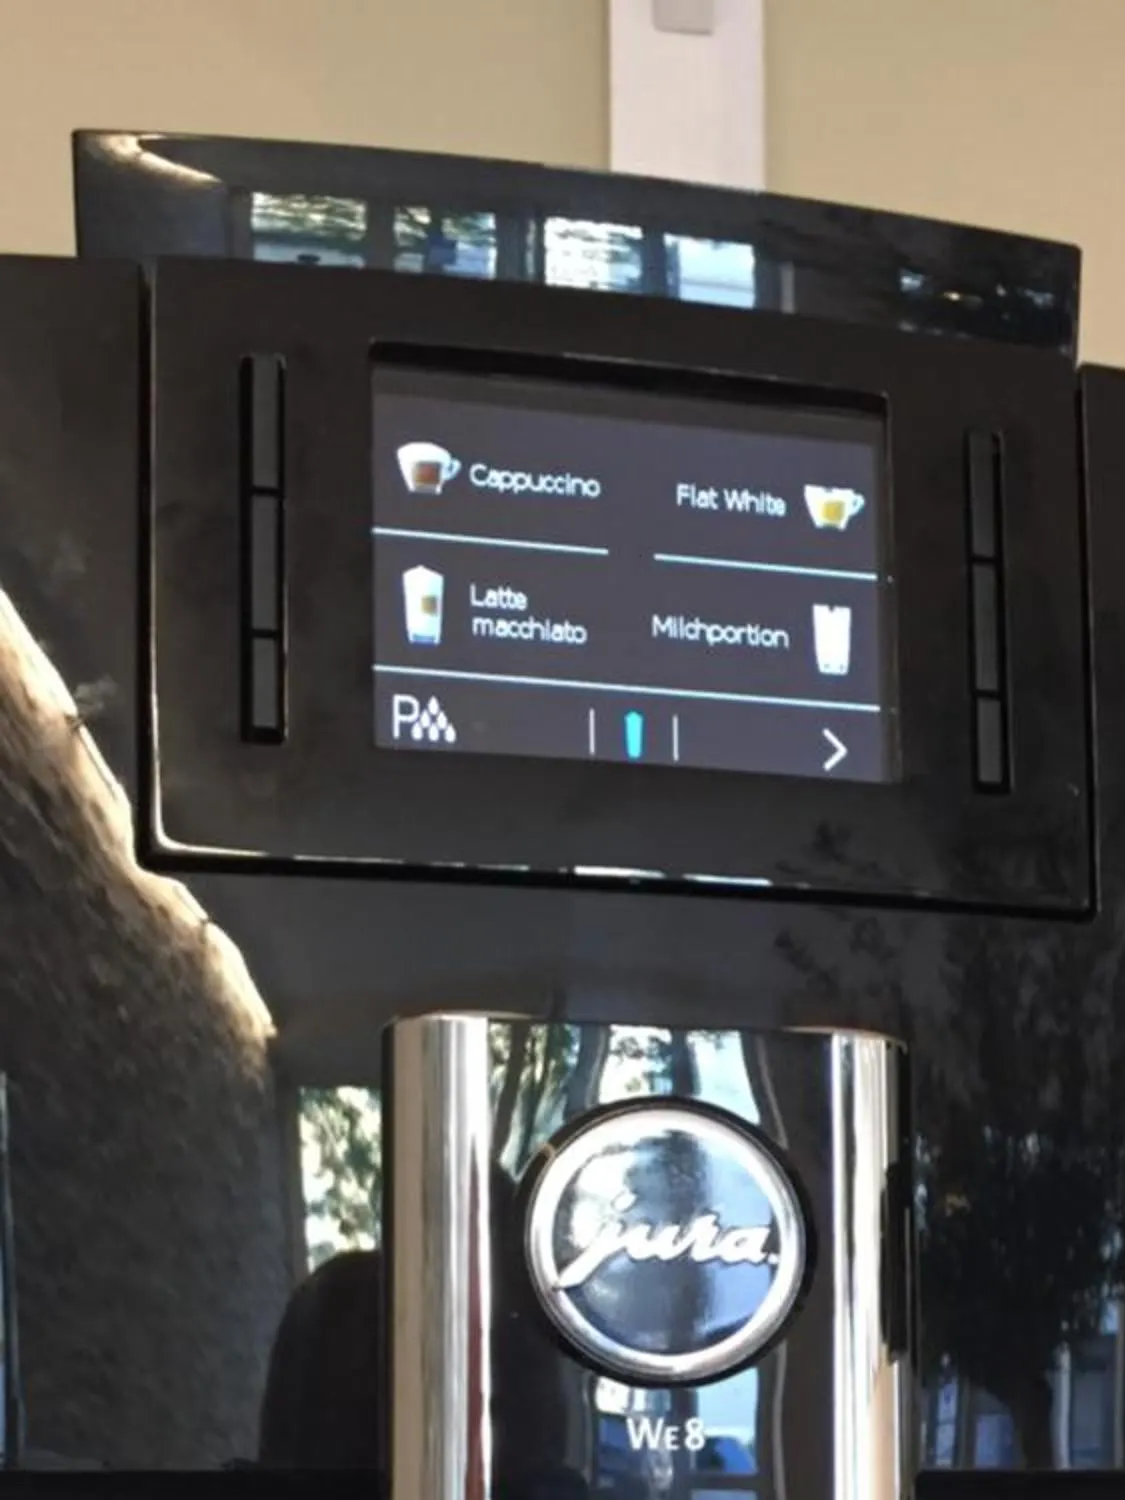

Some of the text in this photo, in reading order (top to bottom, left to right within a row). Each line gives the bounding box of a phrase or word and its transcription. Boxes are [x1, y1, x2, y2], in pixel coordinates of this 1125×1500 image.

[468, 464, 602, 499] Cappuccino
[676, 483, 788, 517] Flat White
[469, 584, 528, 612] Latte
[471, 615, 588, 645] macchiato
[652, 615, 790, 650] Milchportion
